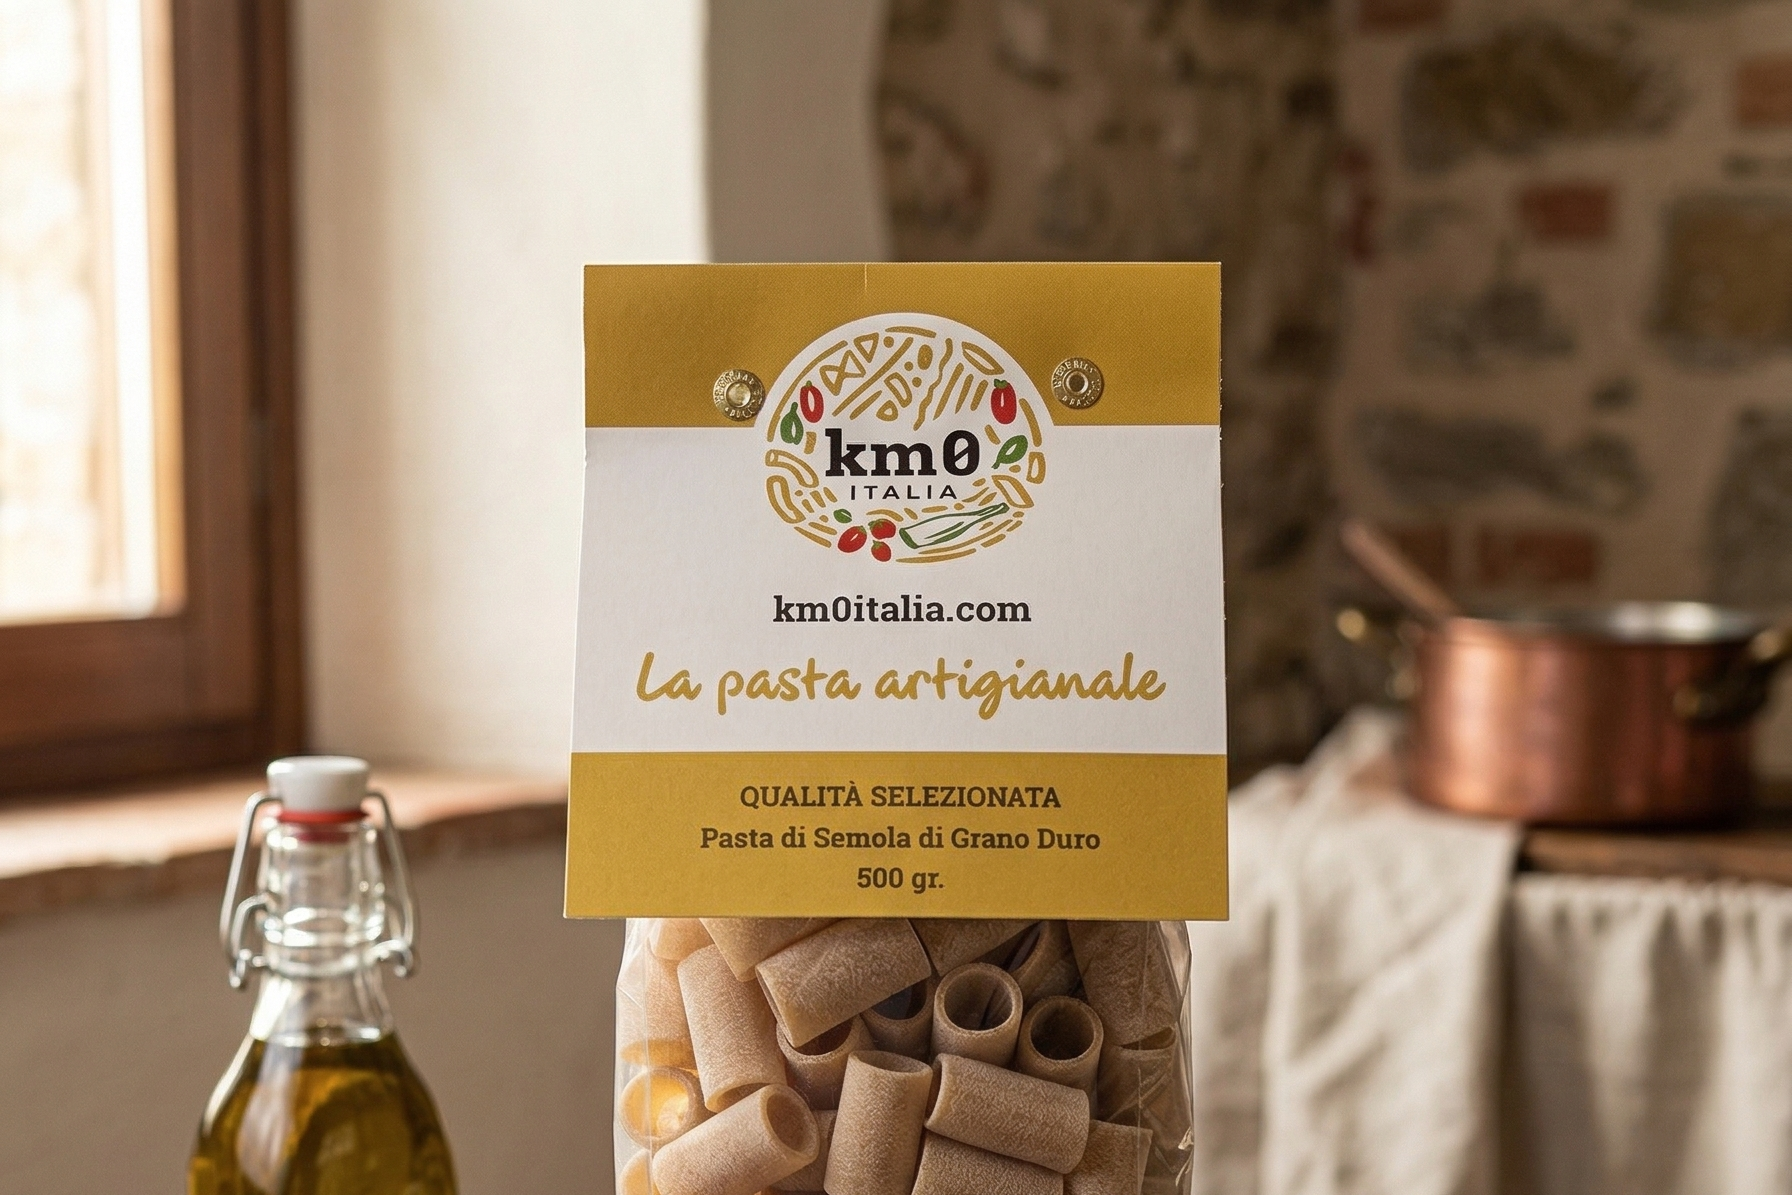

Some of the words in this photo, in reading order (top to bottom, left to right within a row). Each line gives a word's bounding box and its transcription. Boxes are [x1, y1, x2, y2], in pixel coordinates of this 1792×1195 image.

[824, 428, 981, 477] km0
[850, 484, 958, 501] ITALIA
[773, 594, 1032, 623] km0italia.com
[636, 651, 702, 702] La
[717, 657, 862, 716] pasta
[874, 652, 1167, 720] artigianale
[740, 780, 864, 810] QUALITÀ
[870, 785, 1062, 809] SELEZIONATA
[700, 827, 774, 849] Pasta
[781, 825, 807, 849] di
[813, 825, 912, 849] Semola
[918, 825, 945, 849] di
[950, 827, 1030, 850] Grano
[1036, 827, 1101, 850] Duro
[856, 866, 904, 889] 500
[911, 872, 945, 895] gr.
